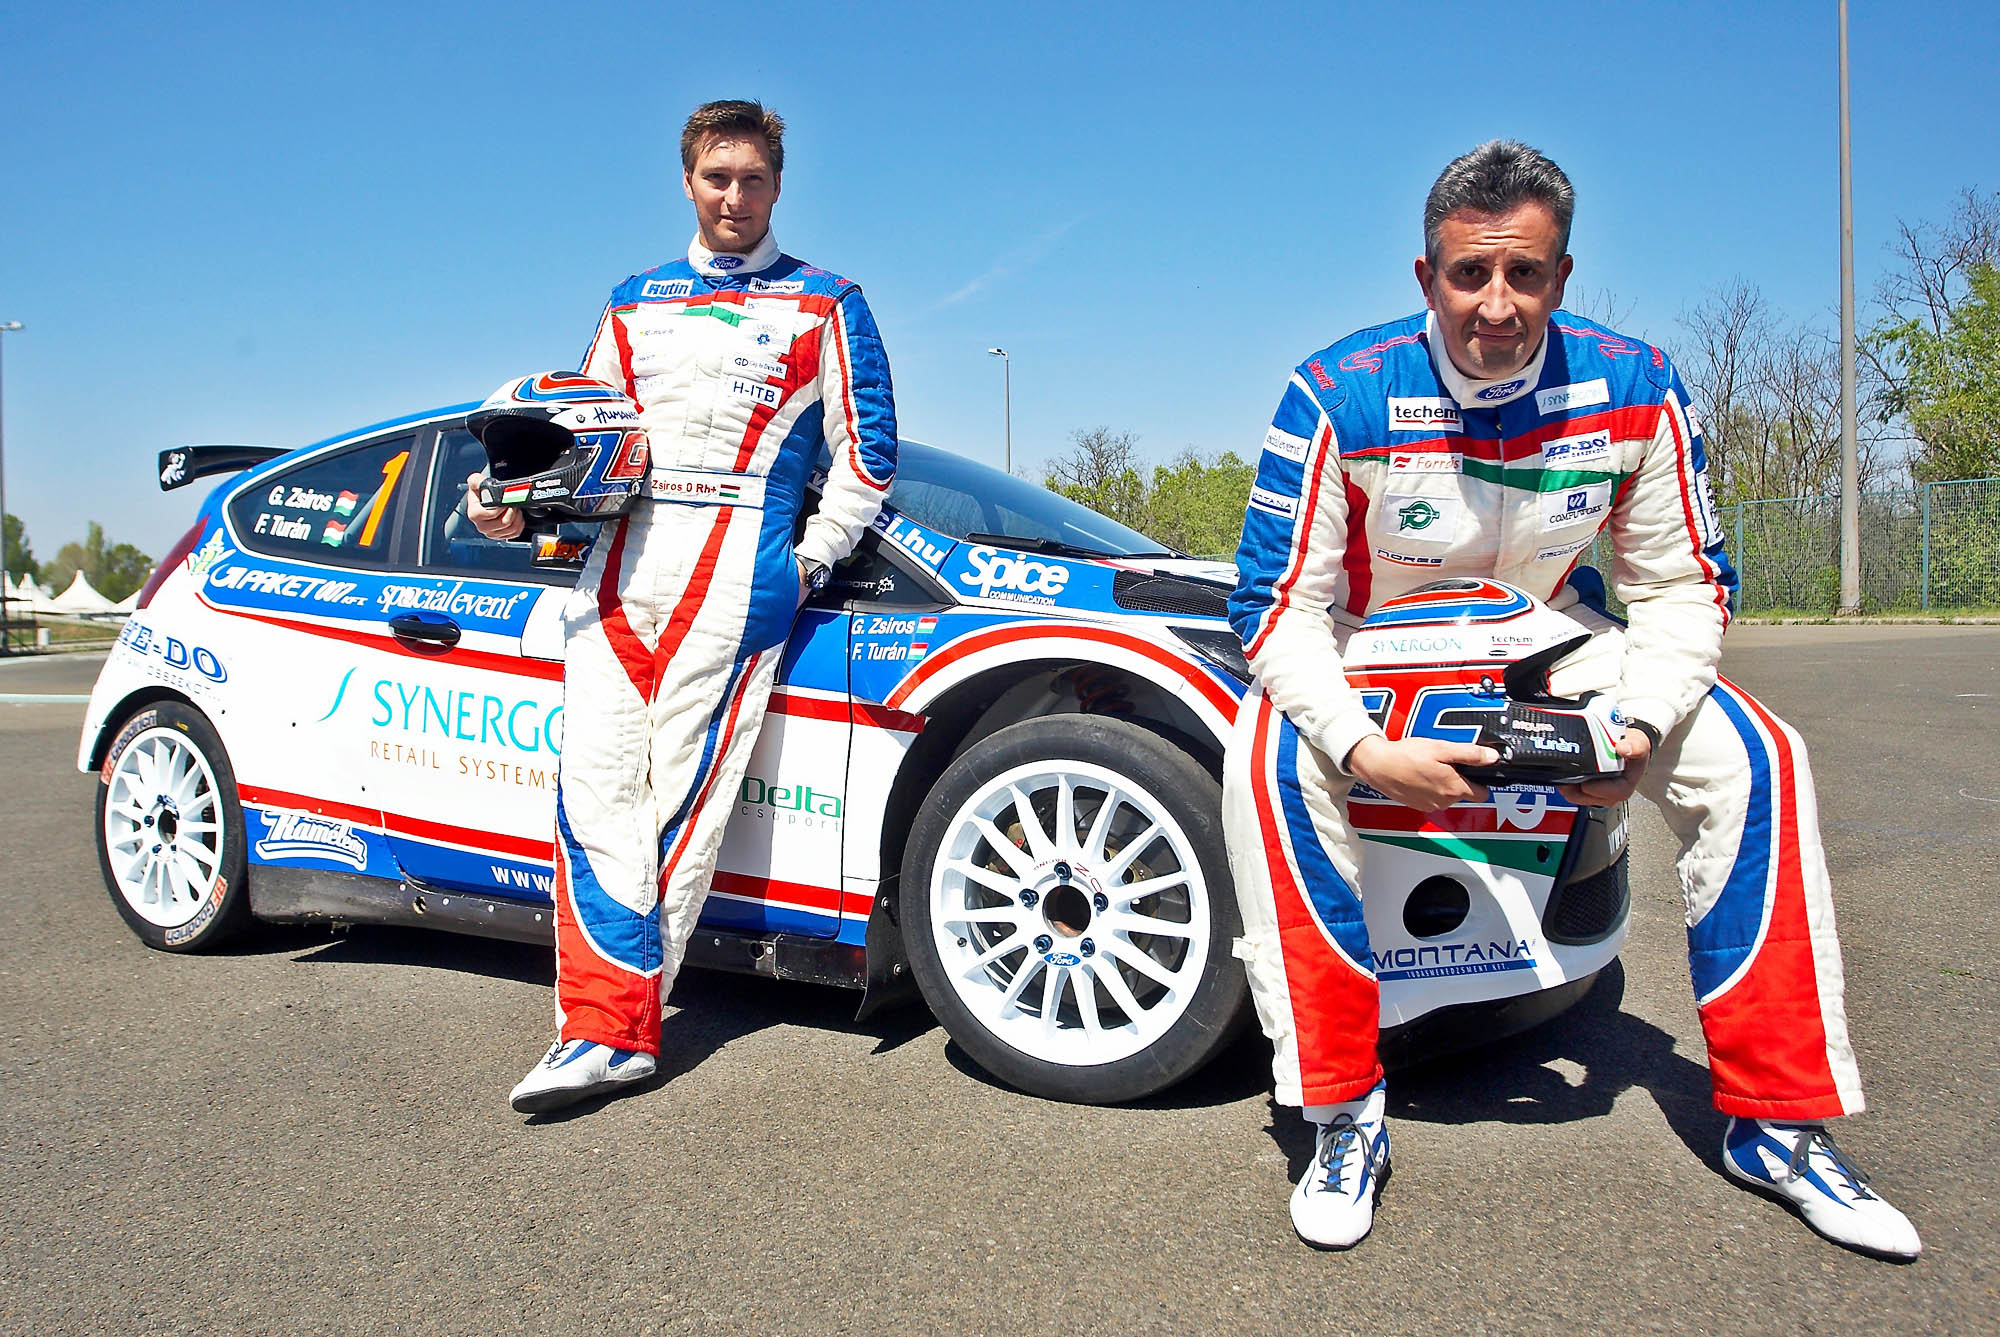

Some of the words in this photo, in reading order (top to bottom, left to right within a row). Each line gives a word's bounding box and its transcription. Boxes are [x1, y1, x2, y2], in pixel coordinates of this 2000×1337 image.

[714, 256, 739, 269] Ford
[733, 381, 776, 403] H-ITB
[1486, 383, 1518, 399] Ford
[1395, 405, 1459, 419] techem
[1417, 456, 1460, 469] Forrás
[652, 480, 683, 492] Zsiros
[696, 484, 717, 493] Rh+
[269, 485, 285, 506] G.
[285, 487, 333, 512] Zsiros
[359, 451, 409, 547] 1
[254, 513, 270, 534] F.
[270, 516, 312, 541] Turán
[960, 546, 1070, 598] Spice
[989, 590, 1056, 606] COMMUNICATION
[851, 618, 865, 635] G.
[868, 616, 916, 635] Zsiros
[1371, 638, 1462, 654] SYNERGON
[1492, 635, 1533, 643] techem
[852, 642, 865, 661] F.
[867, 641, 908, 661] Turán
[371, 740, 440, 769] RETAIL
[459, 755, 559, 791] SYSTEMS
[742, 775, 841, 818] Delta
[742, 806, 839, 832] csoport
[1050, 953, 1075, 966] Ford
